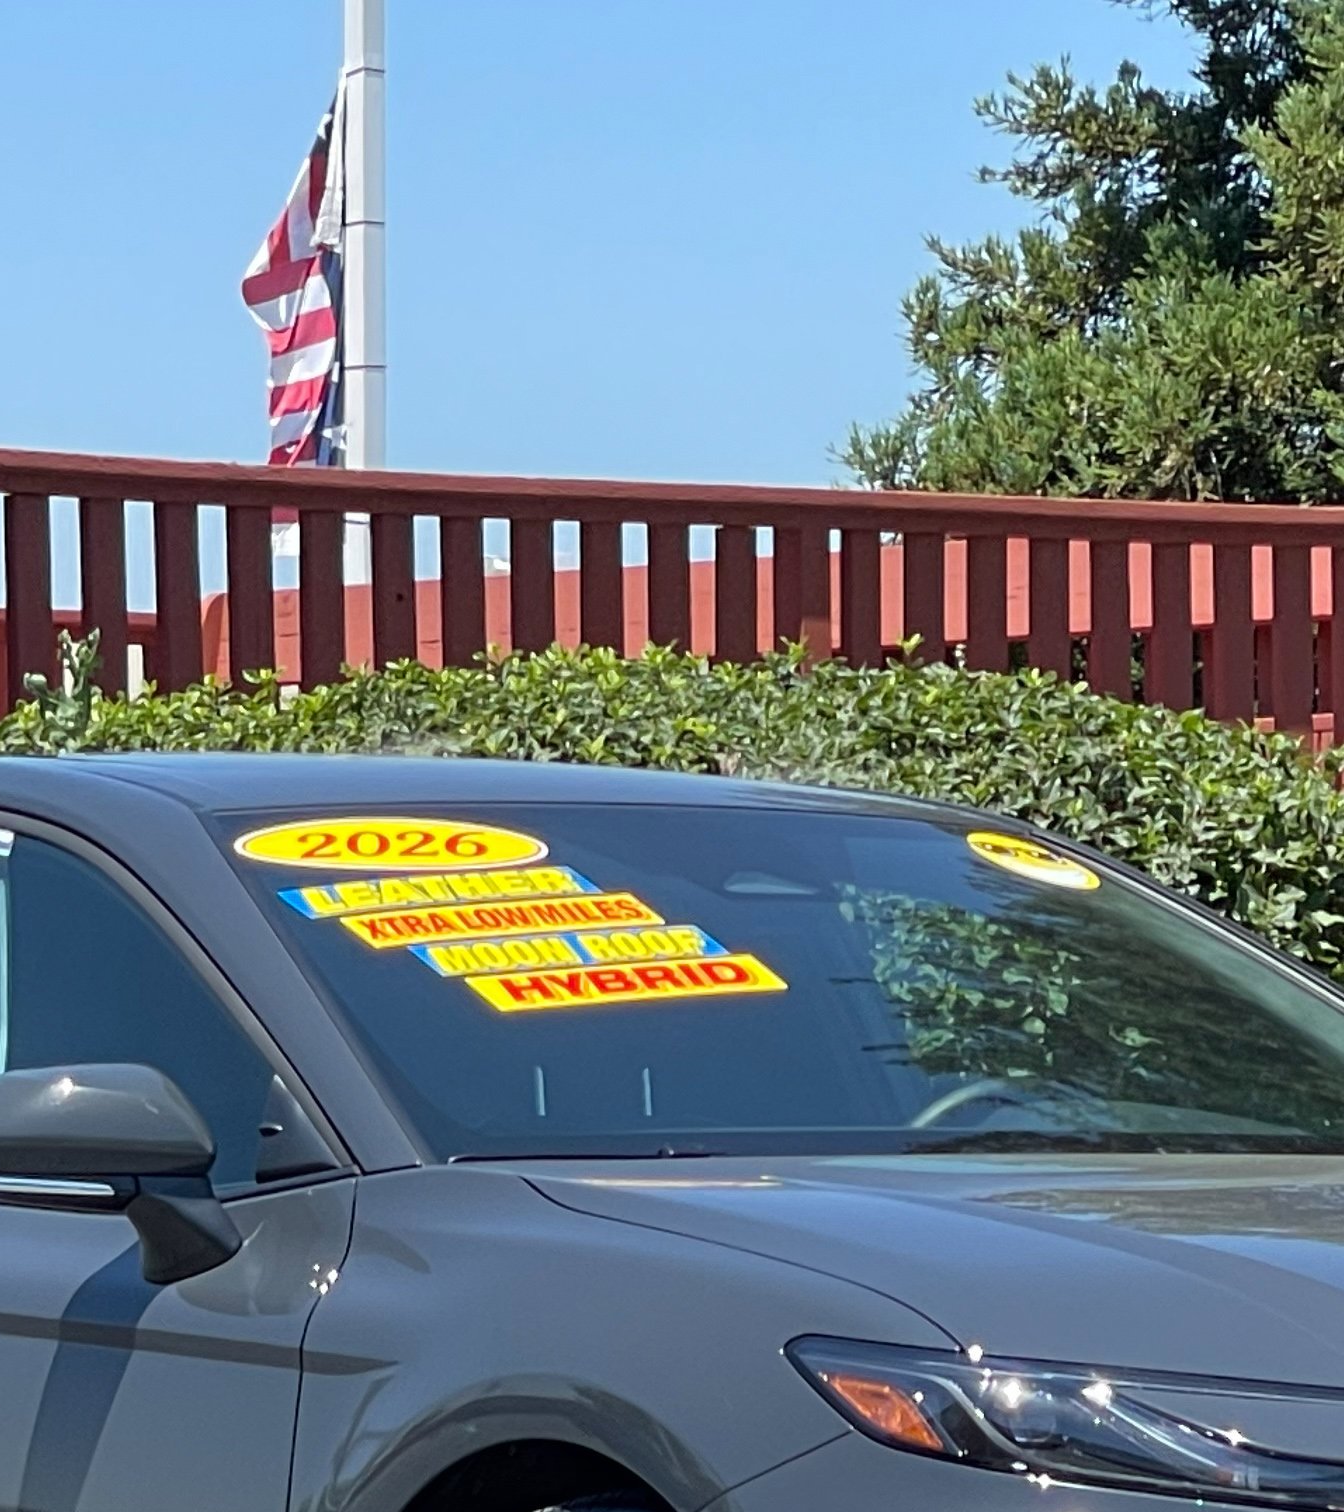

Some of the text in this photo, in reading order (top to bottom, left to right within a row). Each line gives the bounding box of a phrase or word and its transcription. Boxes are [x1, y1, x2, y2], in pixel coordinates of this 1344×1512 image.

[297, 830, 489, 860] 2026
[301, 868, 576, 914] LEATHER
[360, 899, 644, 940] XTRA LOW MILES
[427, 929, 703, 977] MOON ROOF
[497, 961, 750, 1003] HYBRID
